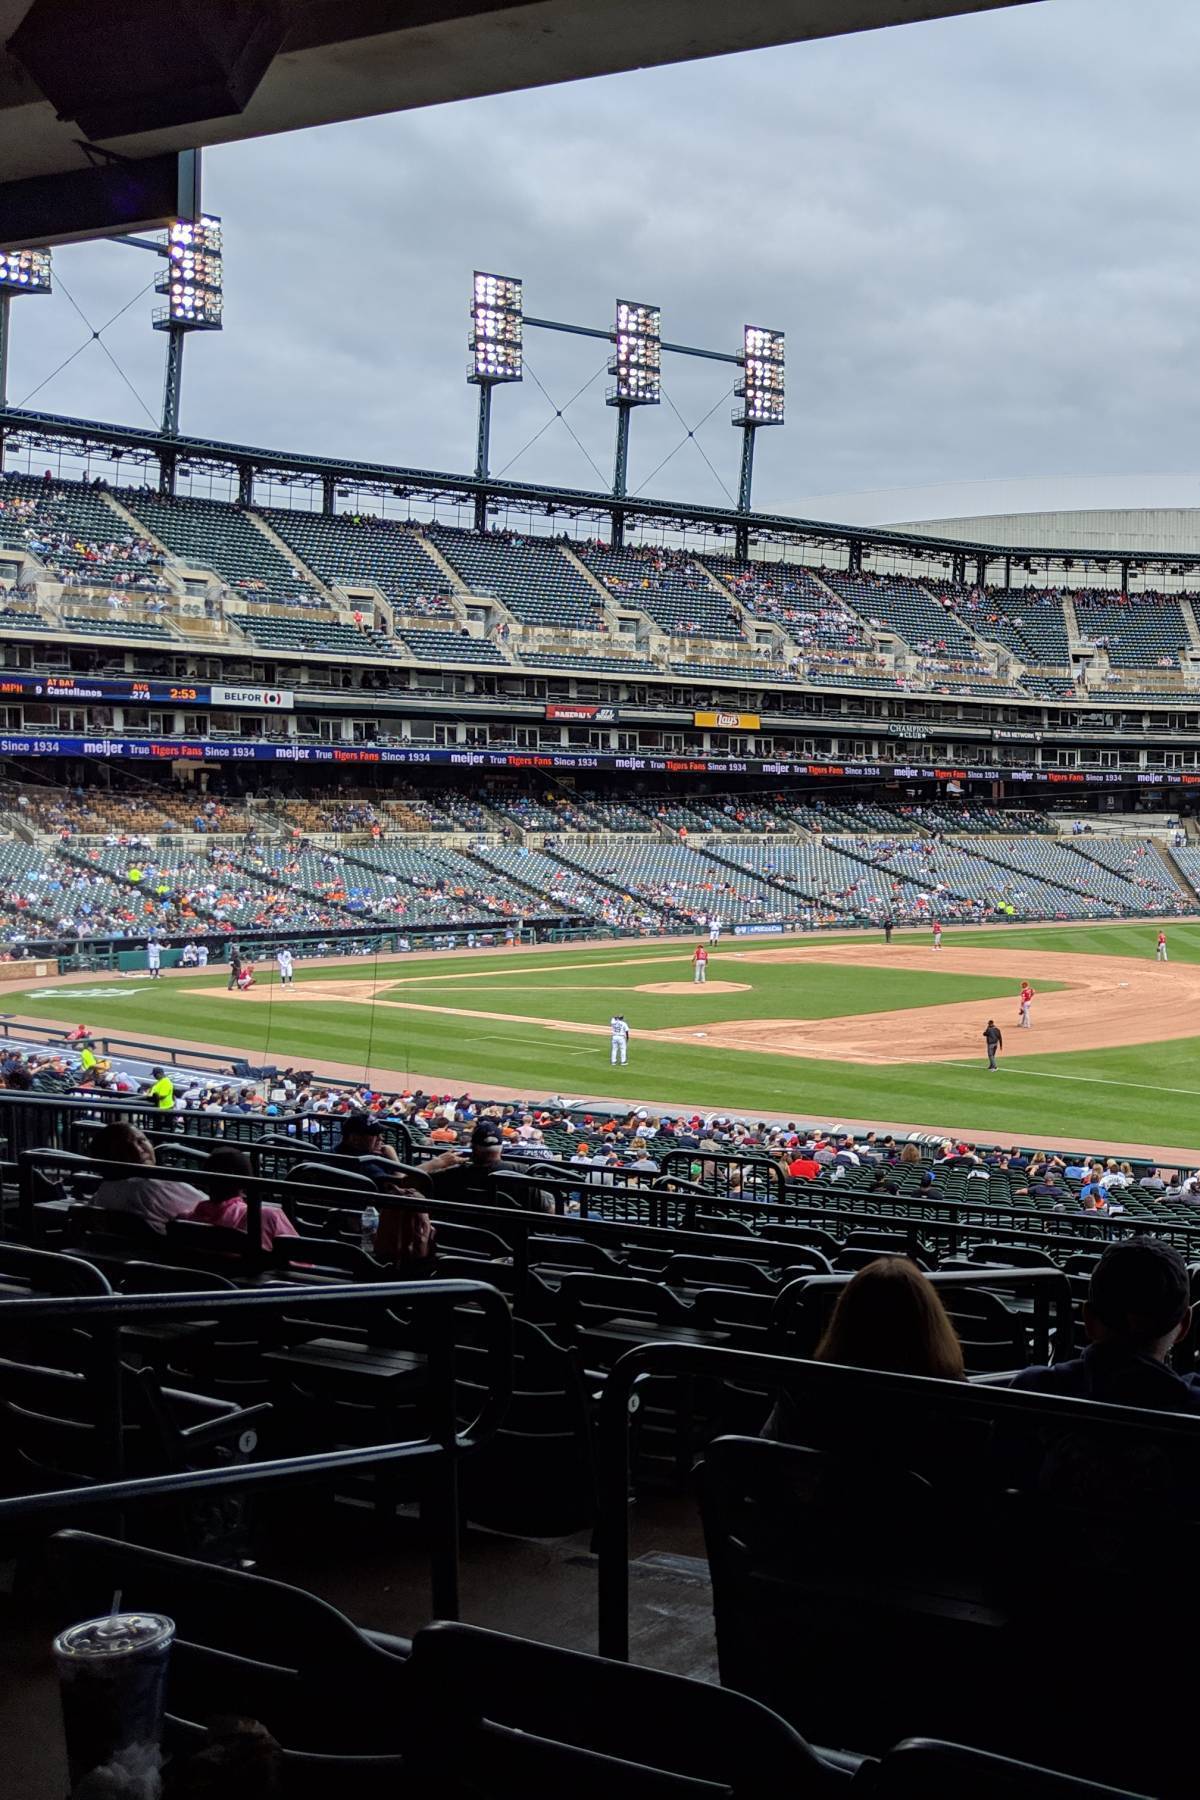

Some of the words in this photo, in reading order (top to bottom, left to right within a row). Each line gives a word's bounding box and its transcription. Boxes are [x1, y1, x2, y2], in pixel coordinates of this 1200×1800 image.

[47, 678, 57, 687] AT
[59, 679, 74, 688] BAT
[133, 683, 149, 692] AVG
[1, 683, 23, 694] MPH
[36, 686, 42, 695] 9
[47, 687, 102, 698] Castellanos
[130, 691, 150, 701] .274
[170, 688, 197, 700] 2:53
[224, 692, 261, 702] BELFOR
[890, 724, 934, 735] CHAMPIONS
[1, 741, 30, 752] Since
[33, 741, 59, 752] 1934
[84, 741, 123, 754] meijer
[129, 745, 149, 754] True
[151, 744, 179, 757] Tigers
[182, 745, 203, 756] Fans
[205, 746, 230, 756] Since
[232, 747, 255, 758] 1934
[276, 748, 309, 761] meijer
[315, 750, 332, 759] True
[334, 751, 357, 762] Tigers
[360, 751, 379, 761] Fans
[381, 751, 406, 762] Since
[409, 752, 430, 762] 1934
[451, 752, 484, 765] meijer
[490, 755, 507, 764] True
[508, 755, 531, 767] Tigers
[534, 757, 552, 766] Fans
[554, 757, 575, 767] Since
[578, 757, 597, 768] 1934
[615, 757, 645, 771] meijer
[650, 760, 665, 770] True
[667, 761, 687, 771] Tigers
[690, 762, 705, 771] Fans
[707, 762, 727, 772] Since
[729, 762, 747, 772] 1934
[763, 763, 789, 775] meijer
[794, 765, 807, 774] True
[809, 765, 826, 775] Tigers
[829, 766, 843, 775] Fans
[845, 766, 862, 776] Since
[864, 767, 880, 776] 1934
[894, 767, 918, 779] meijer
[922, 769, 934, 778] True
[935, 769, 951, 779] Tigers
[953, 770, 966, 778] Fans
[967, 770, 983, 779] Since
[984, 770, 999, 779] 1934
[1012, 770, 1033, 781] meijer
[1036, 772, 1047, 781] True
[1048, 772, 1066, 783] Tigers
[1069, 773, 1084, 782] Fans
[1085, 773, 1103, 782] Since
[1105, 773, 1122, 783] 1934
[1137, 773, 1163, 784] meijer
[1167, 775, 1181, 784] True
[1181, 775, 1200, 785] Tigers
